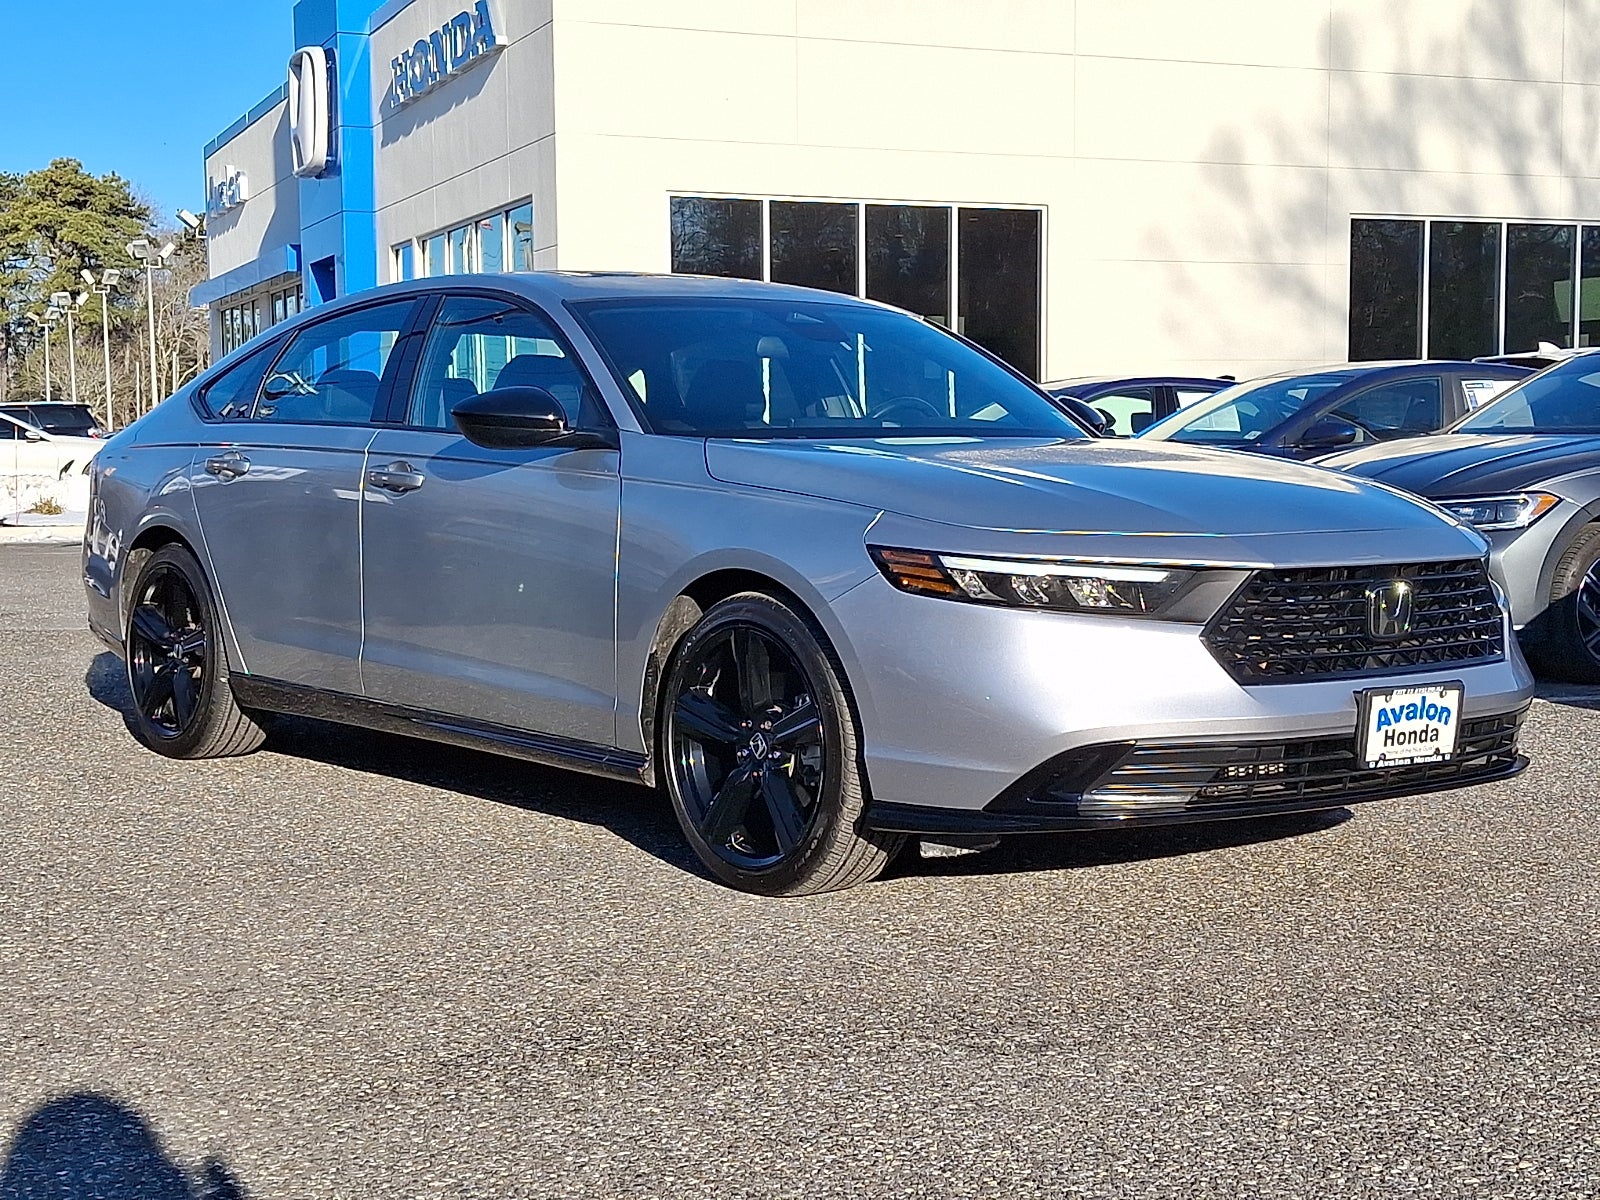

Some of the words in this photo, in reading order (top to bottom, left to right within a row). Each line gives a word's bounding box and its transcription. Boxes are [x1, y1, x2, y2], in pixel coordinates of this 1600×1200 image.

[389, 0, 506, 108] HONDA
[1376, 696, 1451, 732] Avalon
[1383, 724, 1439, 747] Honda
